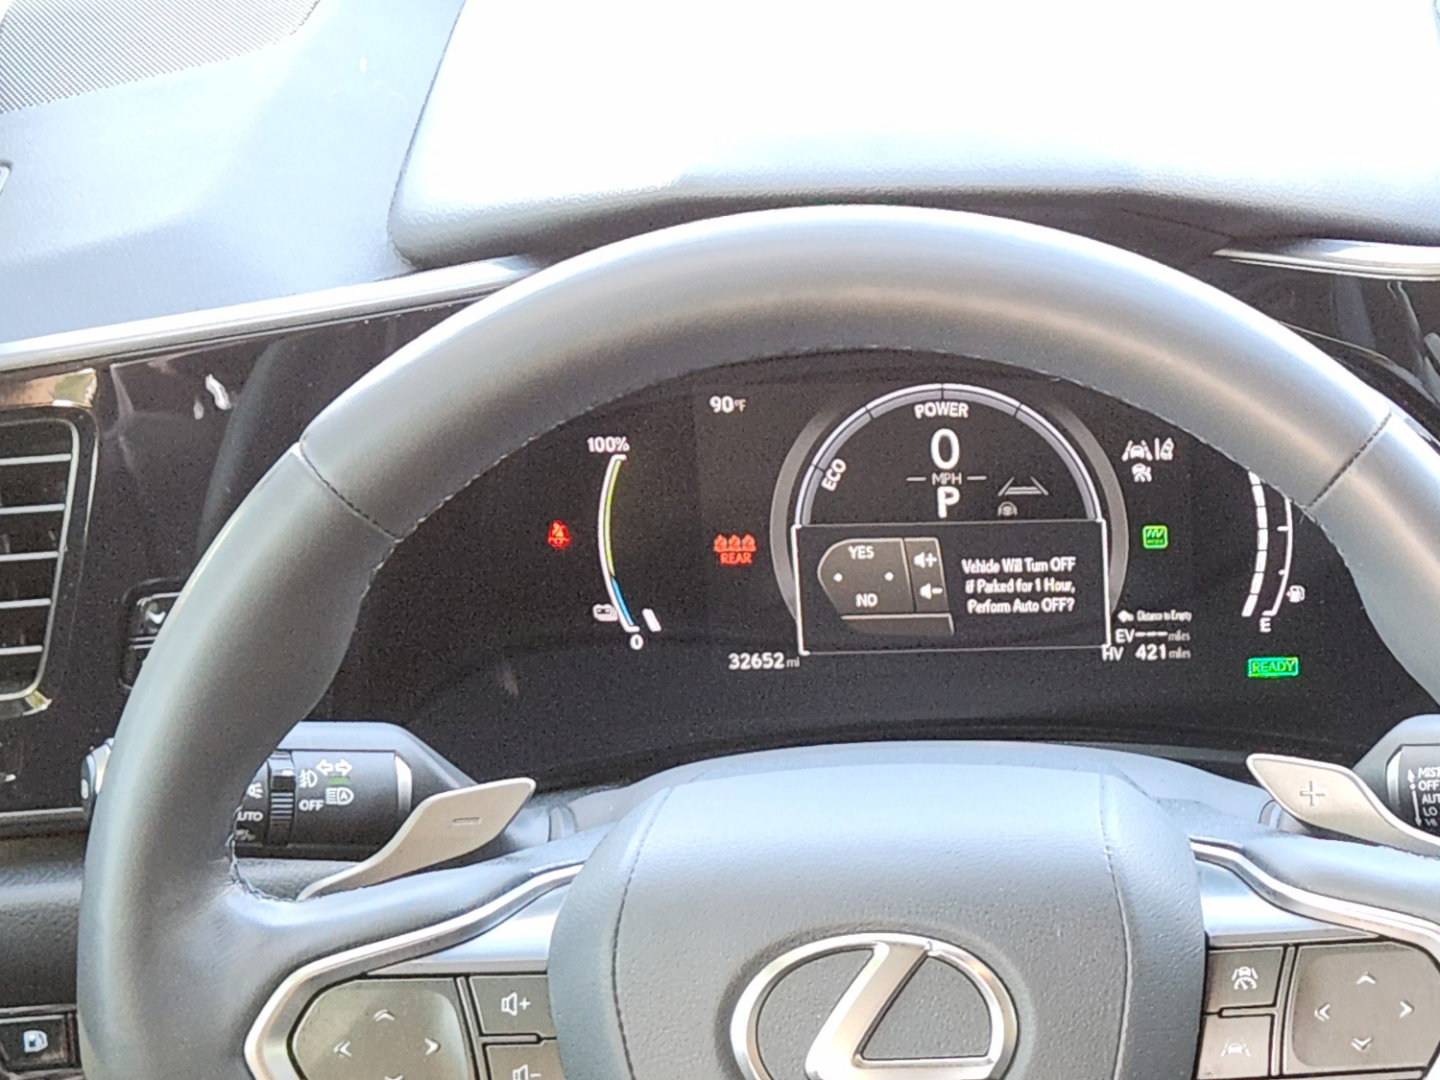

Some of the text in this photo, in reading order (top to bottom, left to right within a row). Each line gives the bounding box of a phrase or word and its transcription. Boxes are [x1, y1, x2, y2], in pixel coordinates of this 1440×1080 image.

[914, 401, 969, 419] POWER
[587, 436, 631, 453] 100%
[930, 428, 960, 470] 0
[821, 458, 847, 491] ECO
[931, 471, 962, 486] MPH
[937, 486, 960, 518] P
[720, 552, 752, 565] REAR
[848, 545, 875, 560] YES
[961, 555, 1077, 574] Vehicle Will Turn OFF
[976, 577, 1014, 594] Parked
[1016, 577, 1033, 593] for
[1034, 577, 1041, 592] 1
[1043, 576, 1076, 595] Hour,
[855, 592, 879, 608] NO
[966, 596, 1076, 614] Perform Auto OFF?
[1259, 617, 1272, 632] E
[630, 634, 644, 649] 0
[1115, 628, 1135, 643] EV
[1102, 645, 1124, 661] HV
[1135, 643, 1167, 661] 421
[728, 652, 785, 670] 32652
[1252, 660, 1295, 673] READY
[1418, 780, 1440, 791] OFF
[298, 799, 325, 812] OFF
[1423, 806, 1438, 817] LO
